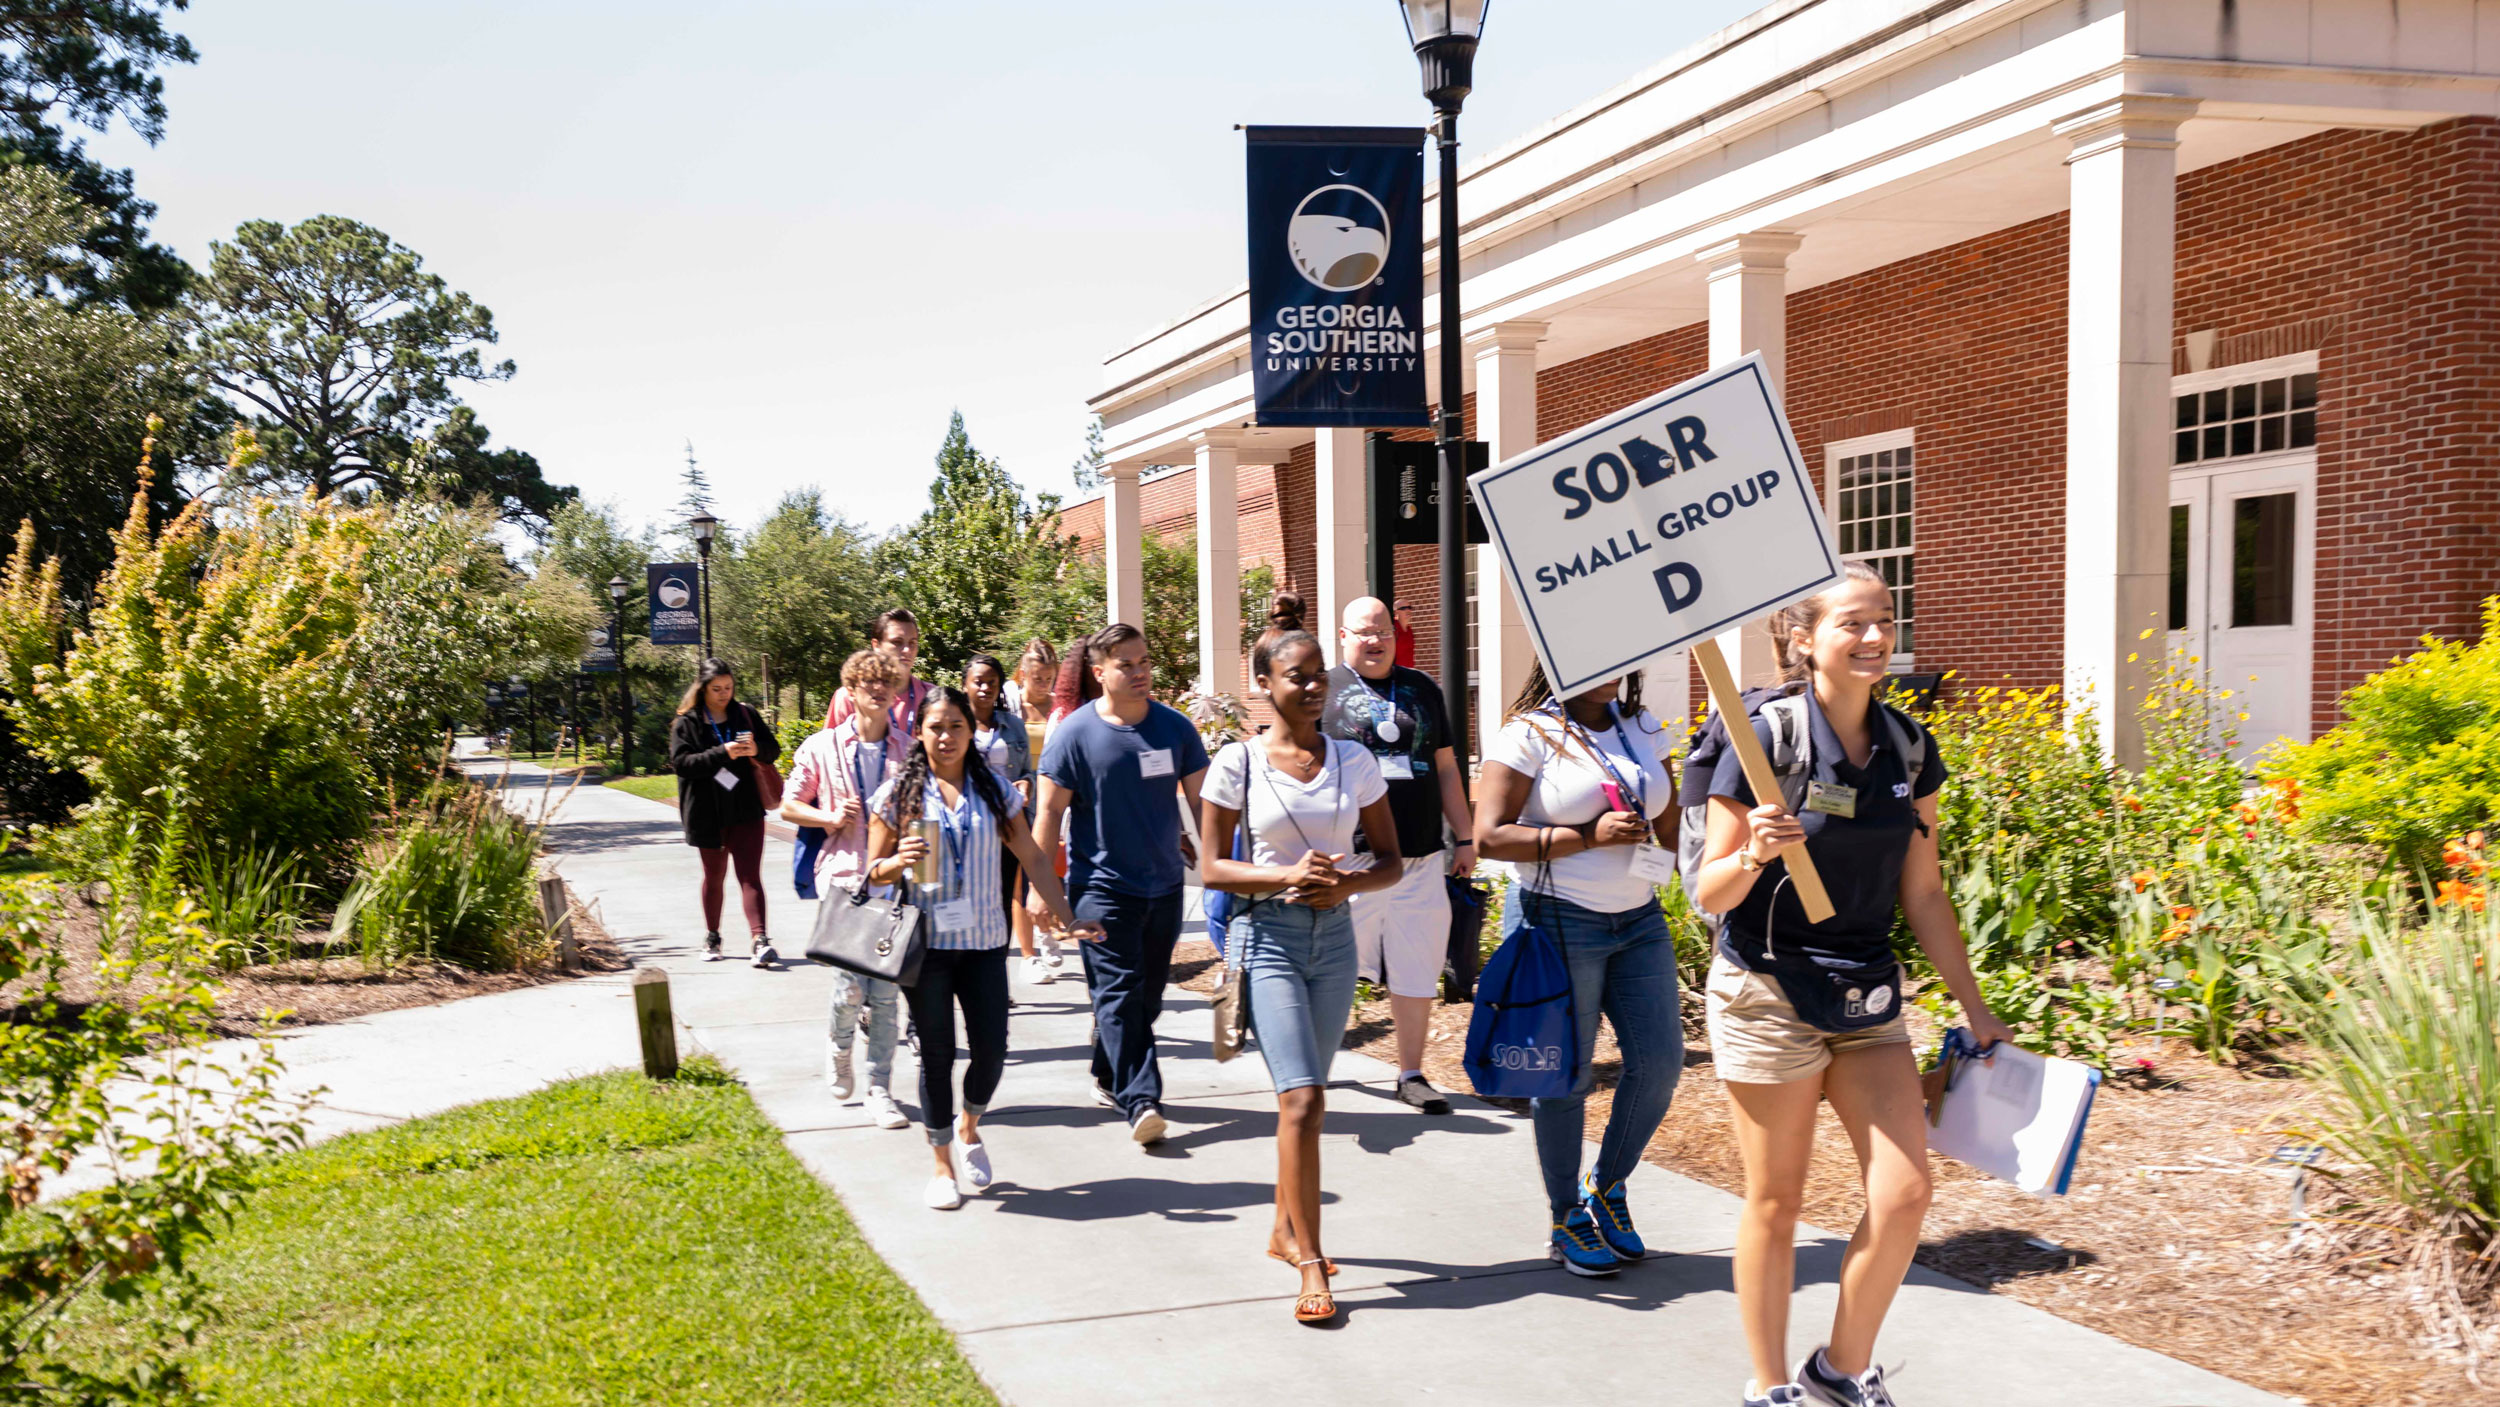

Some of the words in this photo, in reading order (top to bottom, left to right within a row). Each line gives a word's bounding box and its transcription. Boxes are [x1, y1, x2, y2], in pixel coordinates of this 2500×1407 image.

[1276, 305, 1405, 330] GEORGIA
[1267, 330, 1417, 355] SOUTHERN
[1266, 357, 1417, 372] UNIVERSITY
[1535, 529, 1652, 593] SMALL
[1657, 469, 1781, 540] GROUP
[1652, 561, 1704, 615] D
